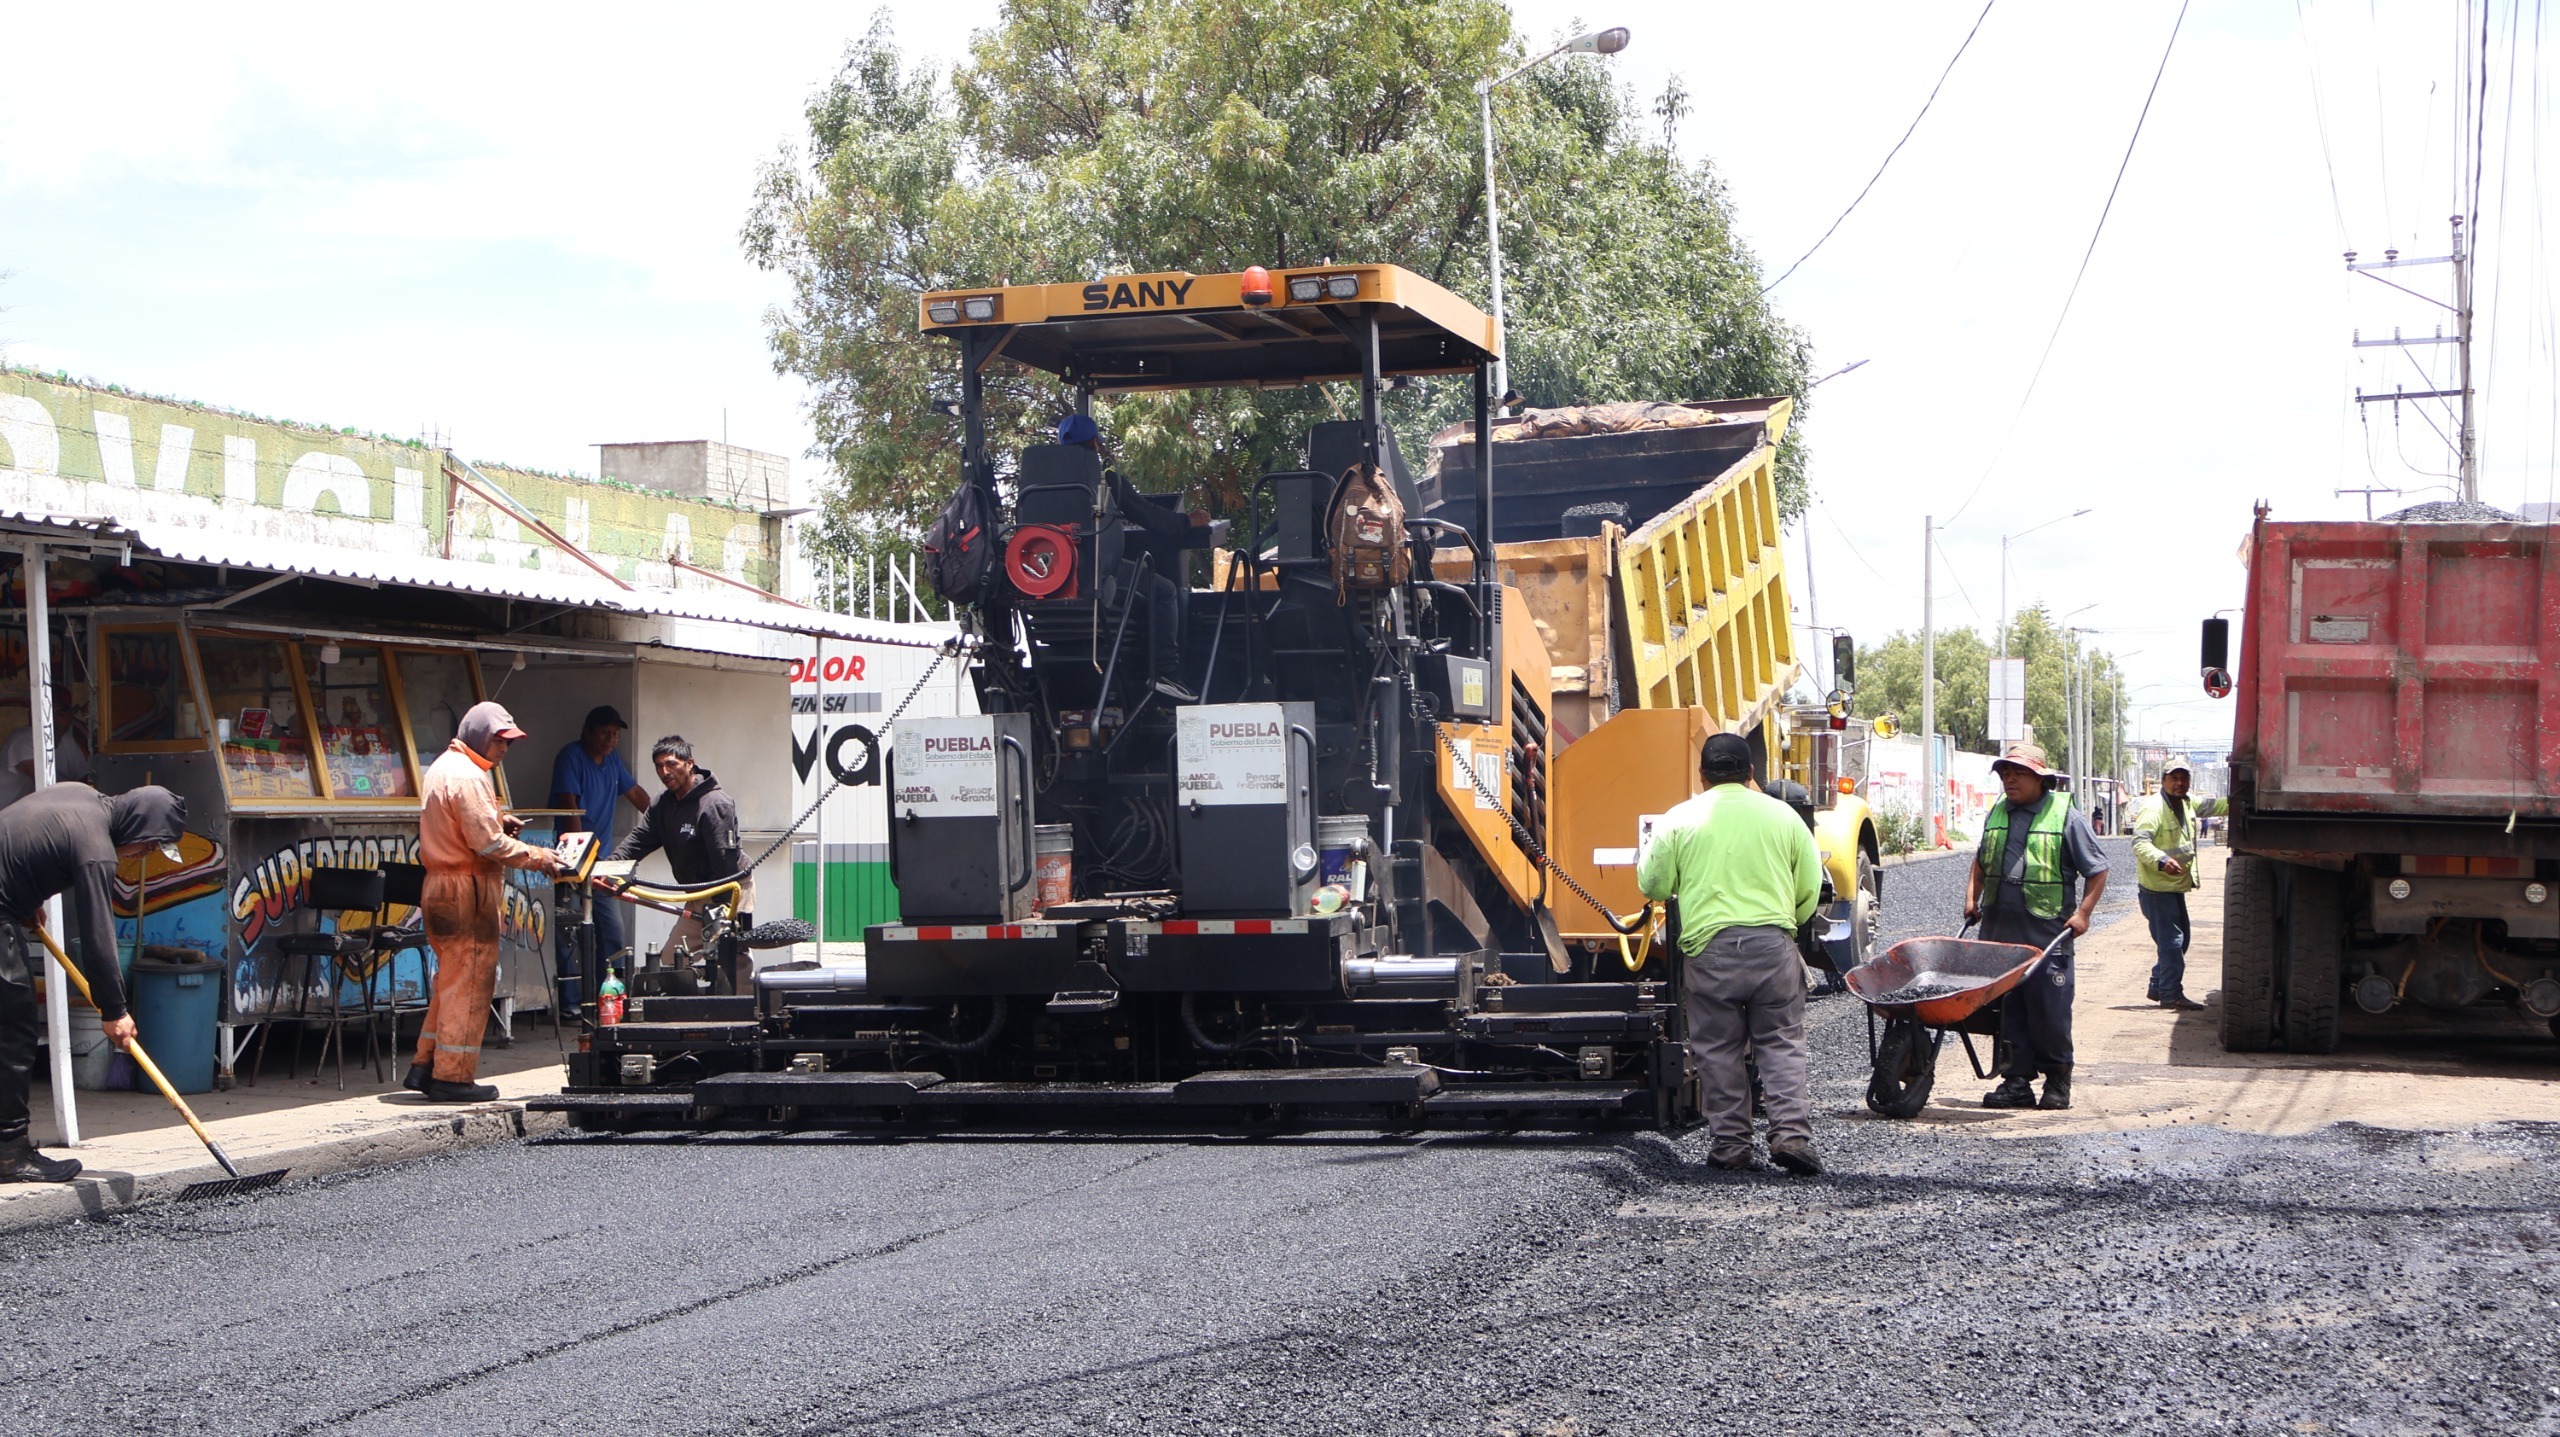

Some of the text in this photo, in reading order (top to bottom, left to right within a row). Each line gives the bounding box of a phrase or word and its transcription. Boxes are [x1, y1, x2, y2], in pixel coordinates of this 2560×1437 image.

[1082, 278, 1195, 311] SANY
[791, 696, 848, 713] FINSH
[1209, 722, 1281, 738] PUEBLA
[925, 736, 992, 752] PUEBLA
[1210, 738, 1244, 747] Gobierno
[925, 752, 957, 760] Gobierno
[1246, 772, 1280, 781] Pensar
[959, 785, 993, 795] Pensar
[1179, 780, 1224, 791] PUEBLA
[1248, 780, 1285, 790] Grande
[895, 793, 938, 803] PUEBLA
[962, 793, 995, 802] Grande
